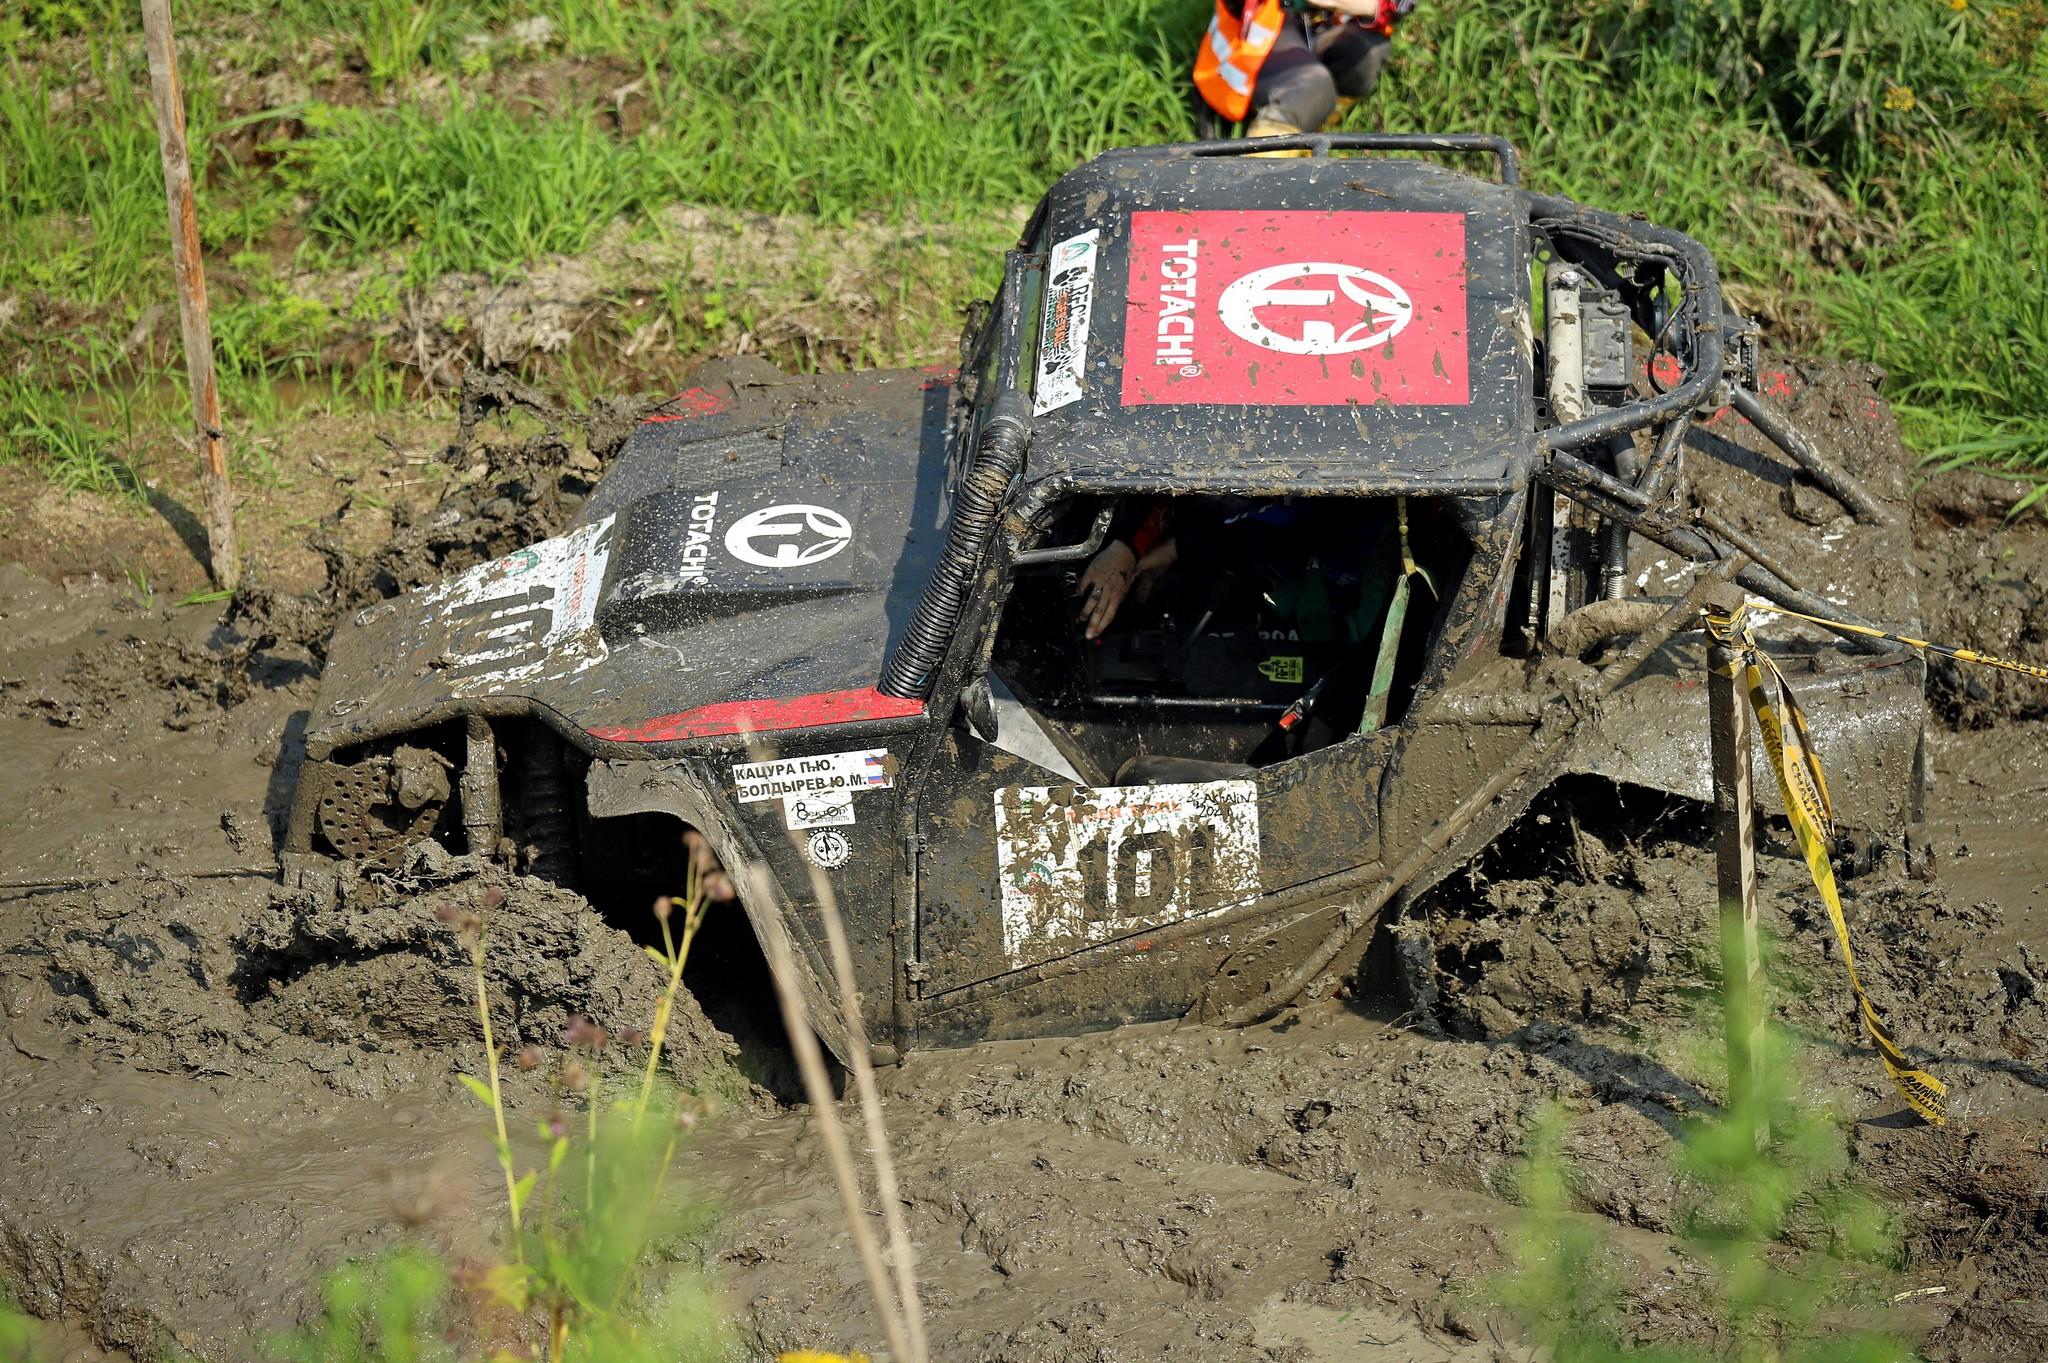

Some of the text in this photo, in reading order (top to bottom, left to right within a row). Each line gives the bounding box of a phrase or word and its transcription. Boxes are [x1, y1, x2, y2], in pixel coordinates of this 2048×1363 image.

[1156, 239, 1198, 365] TOTACHI
[679, 490, 720, 578] TOTACHI
[735, 763, 796, 781] КАЦУРА
[739, 778, 826, 798] БОЛДЫРЕВ
